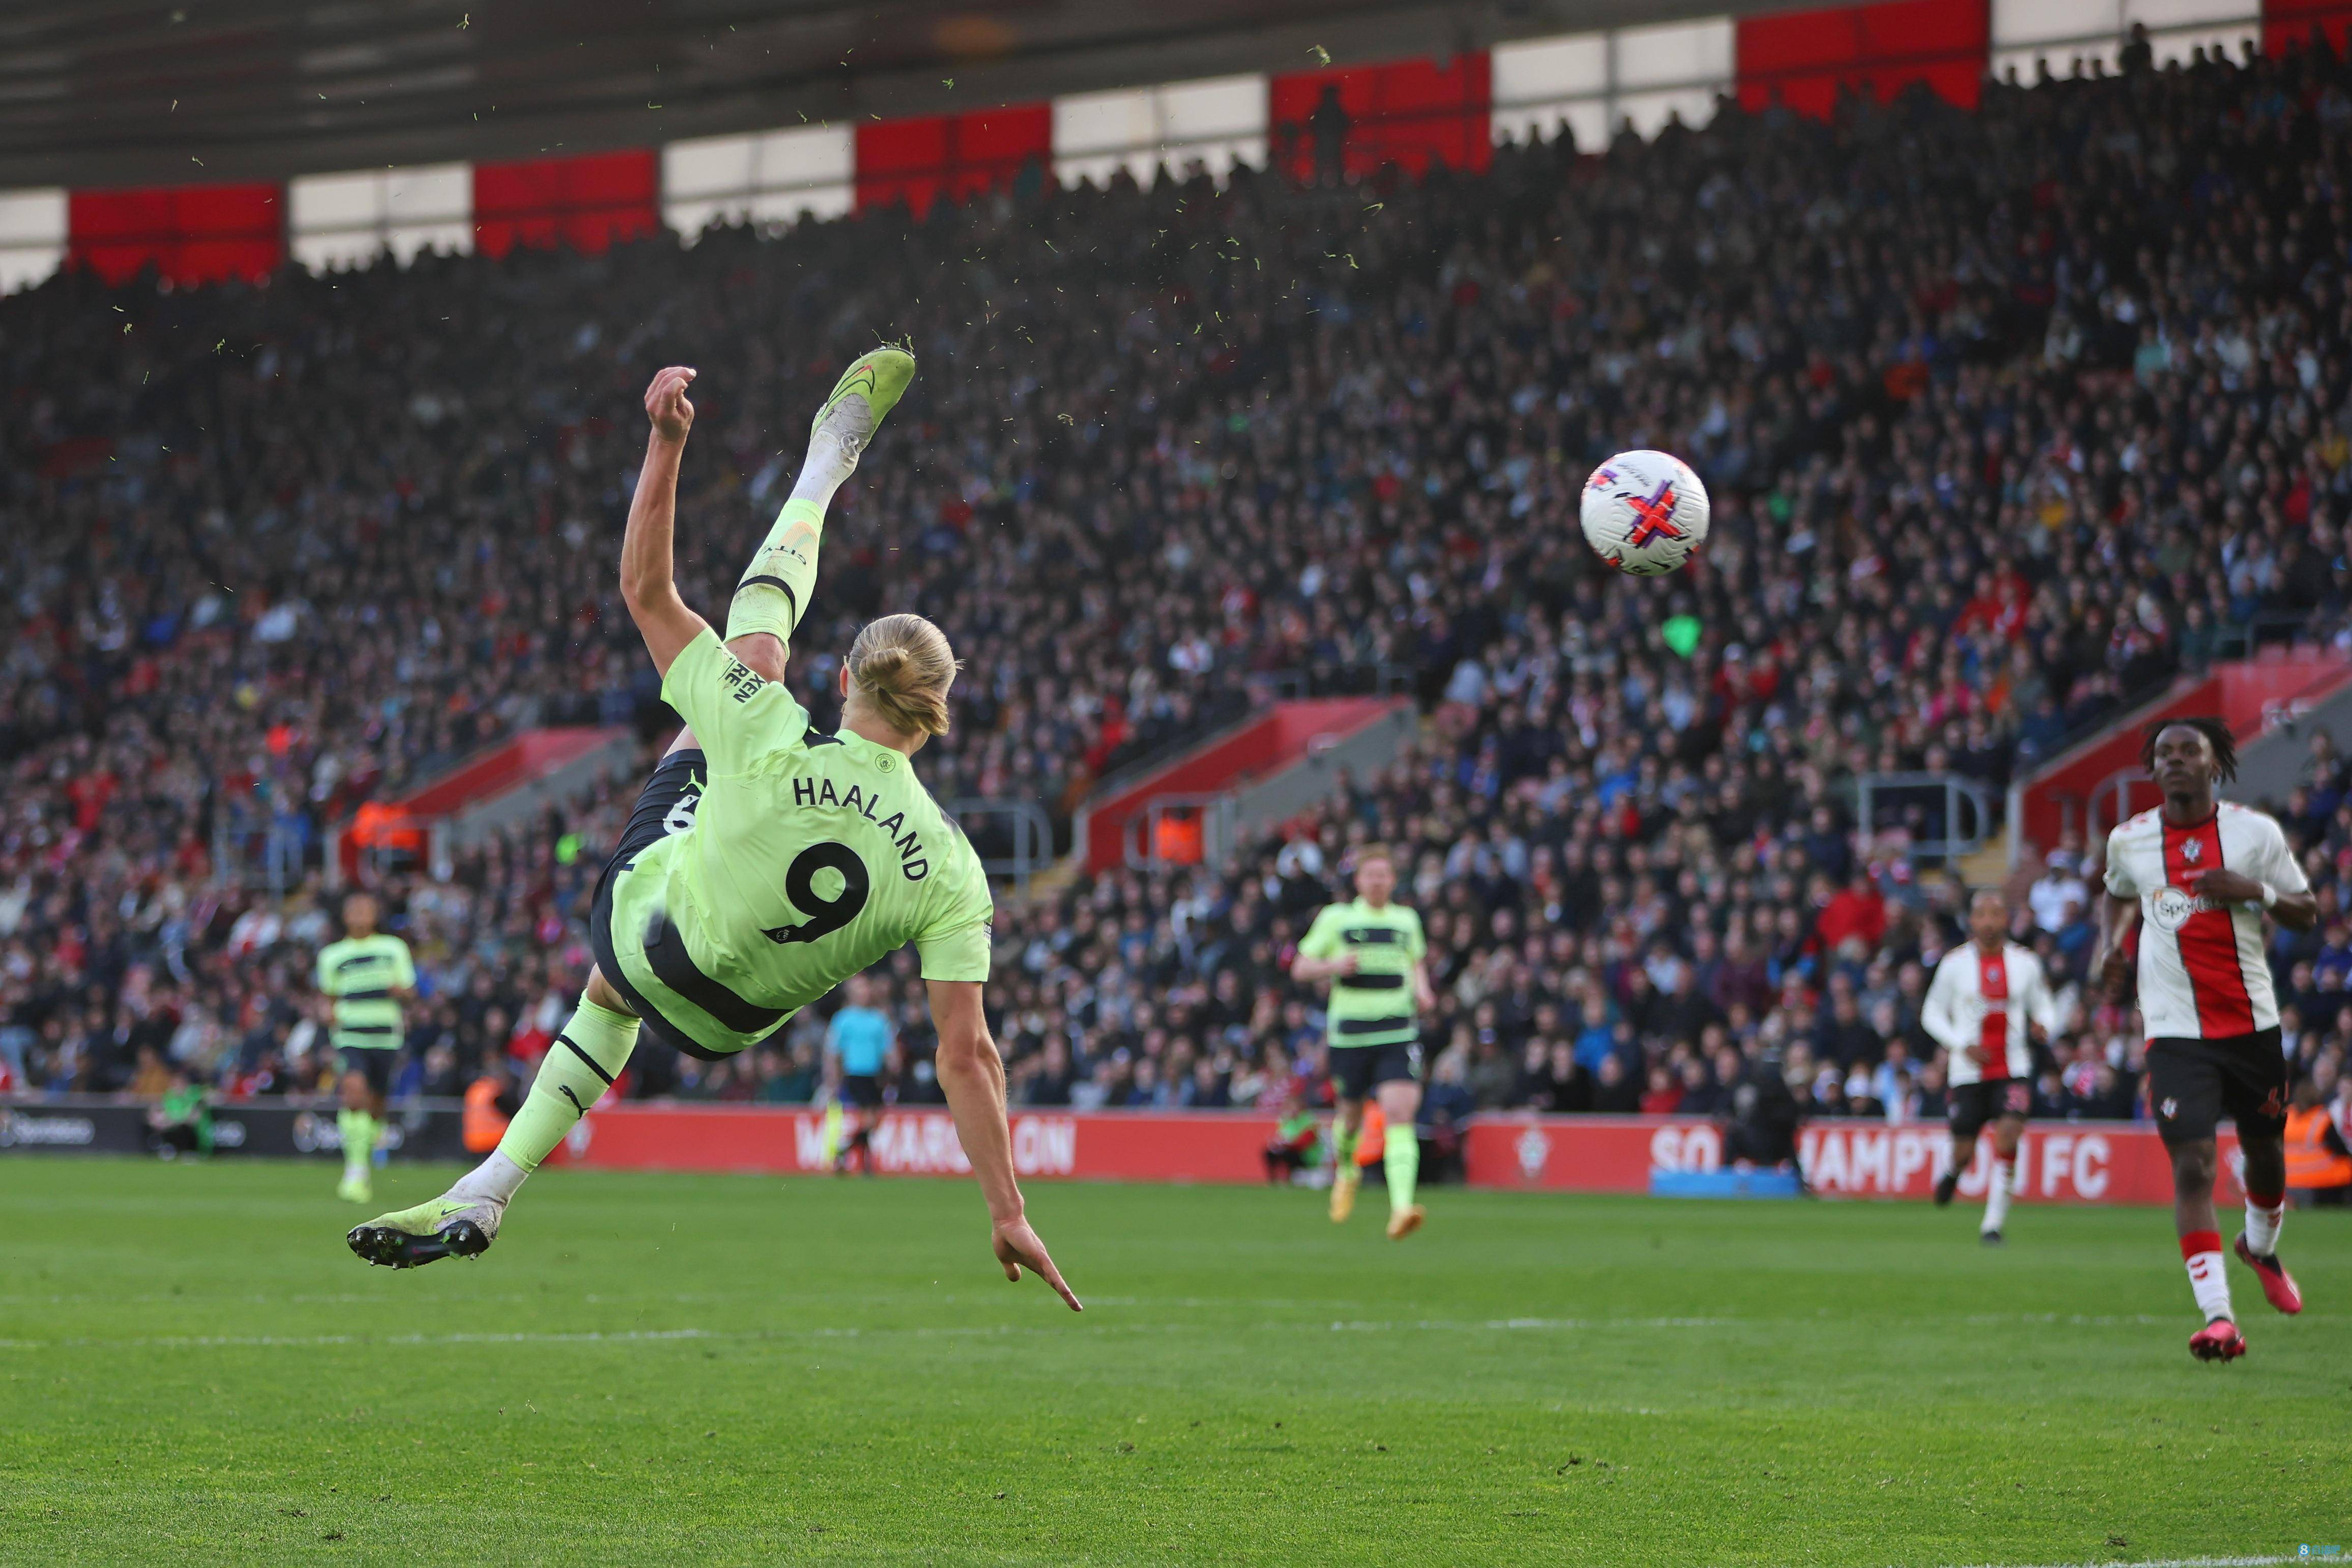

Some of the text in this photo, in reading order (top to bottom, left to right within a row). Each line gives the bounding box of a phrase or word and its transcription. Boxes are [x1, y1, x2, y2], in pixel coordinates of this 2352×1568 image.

[724, 663, 750, 687] RE
[733, 674, 766, 704] XEN
[793, 777, 928, 881] HAALAND
[761, 842, 870, 944] 9
[1013, 1115, 1077, 1176] ON
[2041, 1135, 2110, 1200] FC
